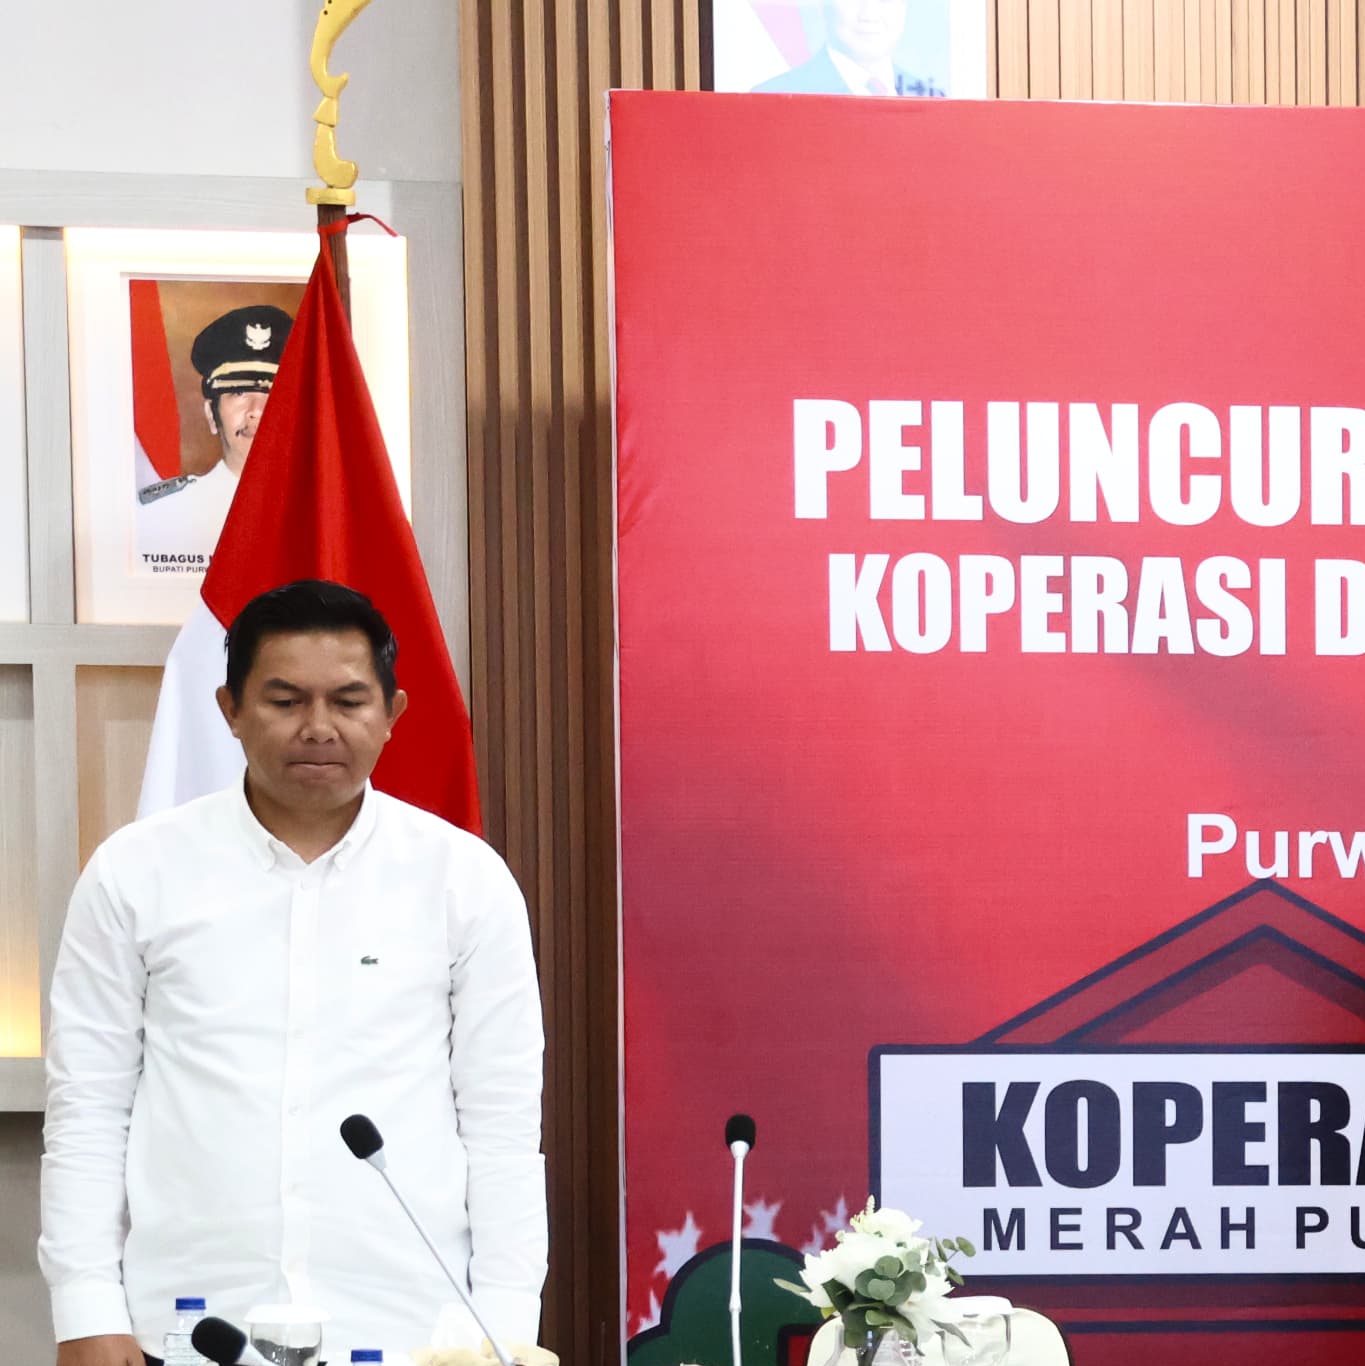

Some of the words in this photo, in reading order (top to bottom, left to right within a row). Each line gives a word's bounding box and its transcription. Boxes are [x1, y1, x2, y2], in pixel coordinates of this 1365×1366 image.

[142, 554, 204, 563] TUBAGUS
[152, 565, 184, 573] BUPATI
[829, 553, 1286, 656] KOPERASI
[984, 1206, 1256, 1250] MERAH
